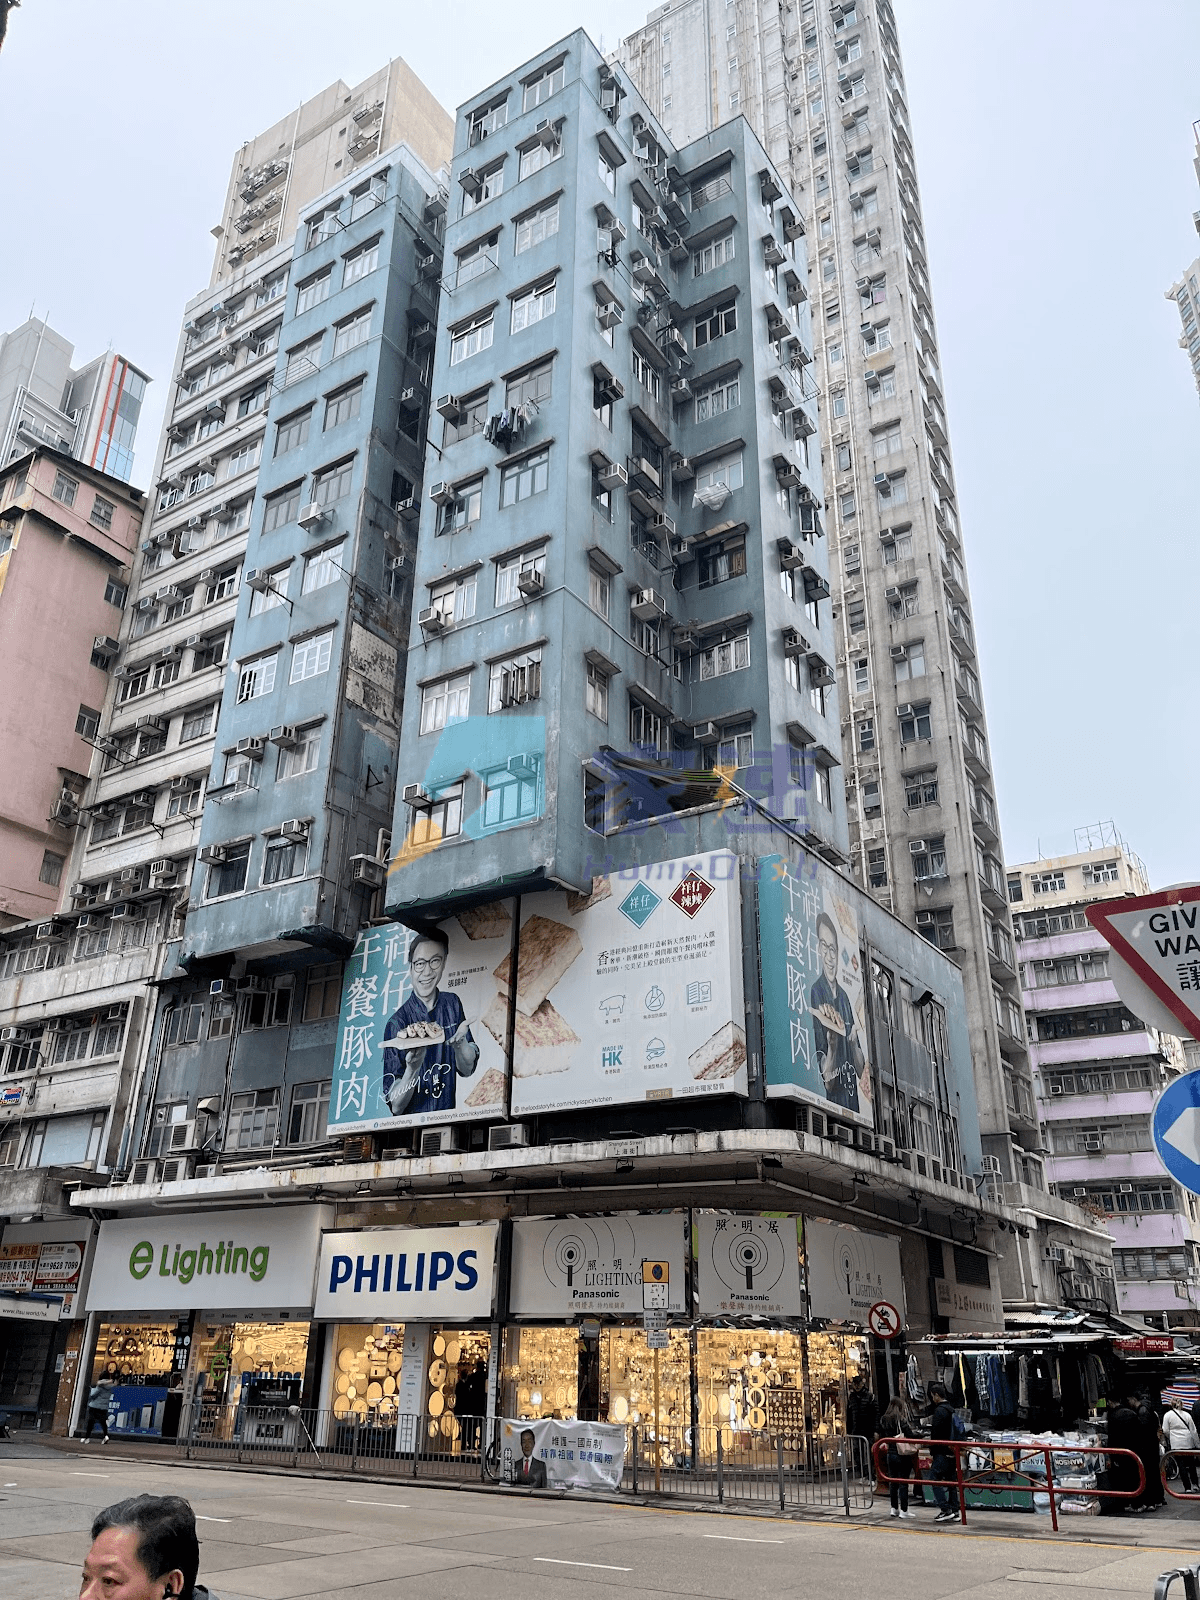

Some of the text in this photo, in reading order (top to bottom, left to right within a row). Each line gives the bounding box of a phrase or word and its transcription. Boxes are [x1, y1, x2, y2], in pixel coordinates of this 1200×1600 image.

[681, 880, 702, 895] 祥仔
[630, 894, 651, 909] 祥仔
[801, 881, 821, 976] 祥仔
[380, 925, 418, 1016] 祥仔
[781, 863, 810, 1071] 午餐豚肉
[335, 932, 382, 1120] 午餐豚肉
[602, 1050, 622, 1067] HK
[129, 1240, 270, 1284] e Lighting
[329, 1250, 478, 1293] PHILIPS
[572, 1289, 620, 1299] Panasonic
[730, 1293, 770, 1301] Panasonic
[851, 1298, 872, 1308] Panasonic
[540, 1448, 614, 1465] 背靠祖國 聯通國際
